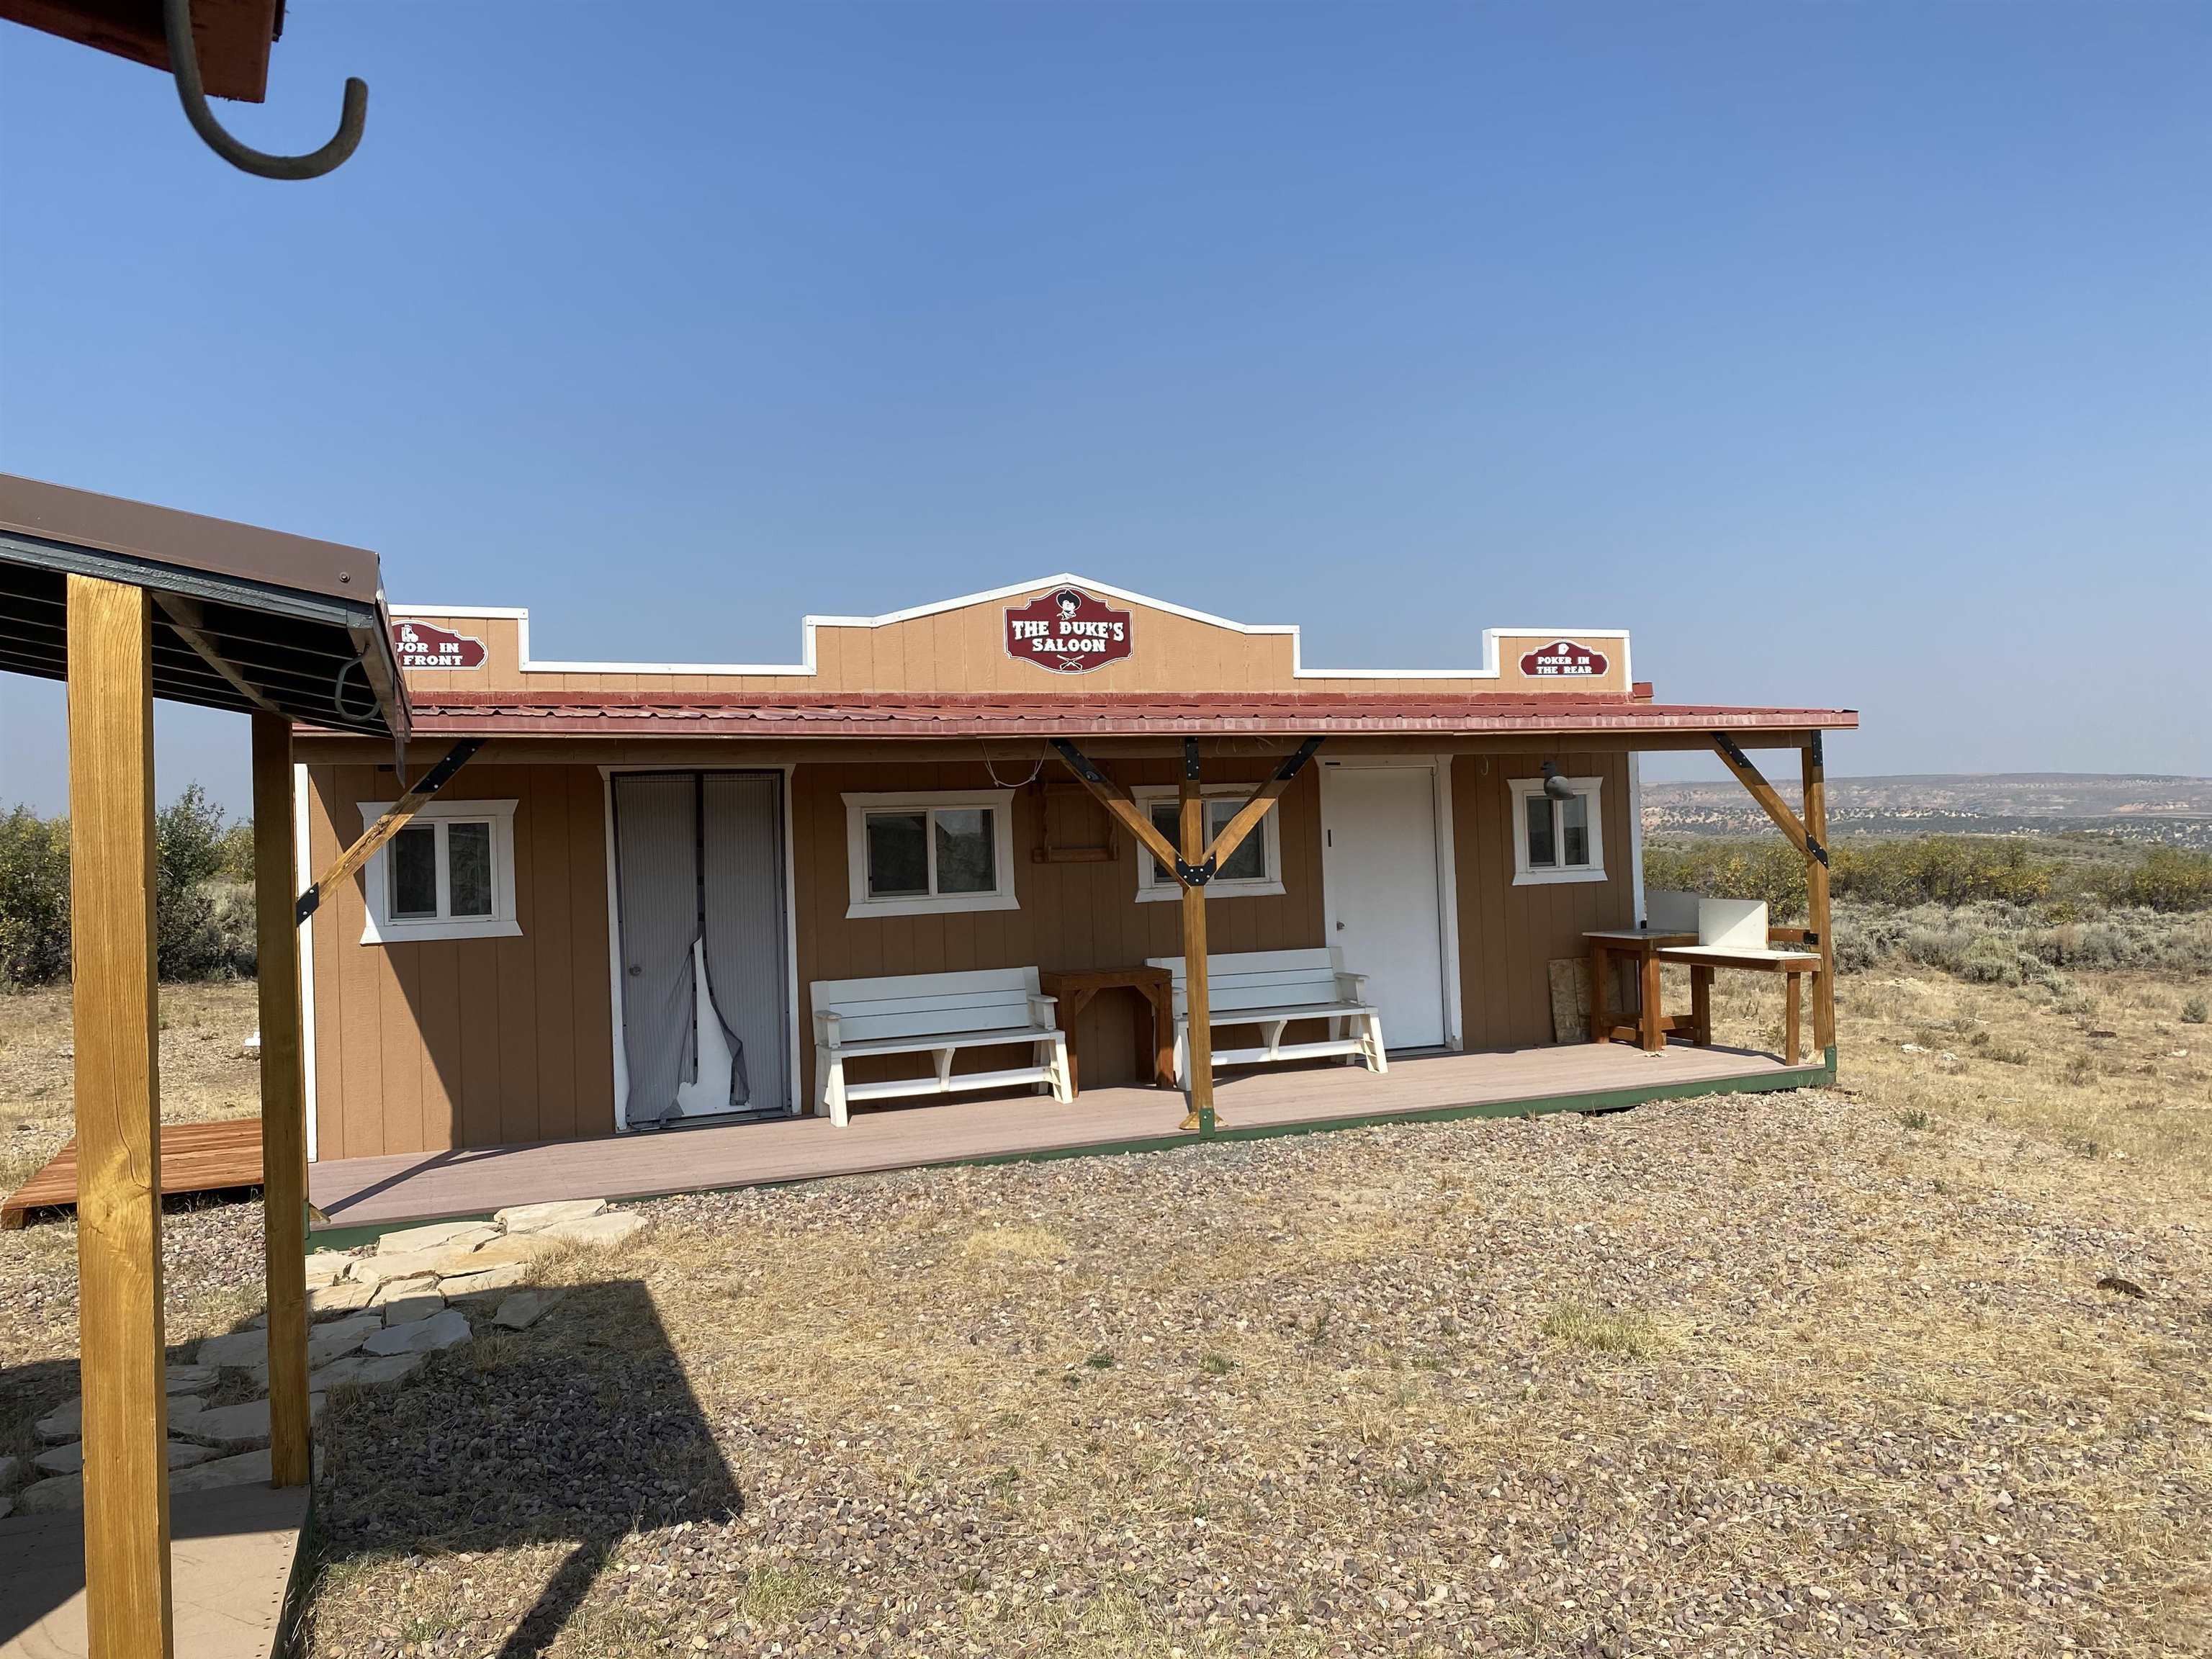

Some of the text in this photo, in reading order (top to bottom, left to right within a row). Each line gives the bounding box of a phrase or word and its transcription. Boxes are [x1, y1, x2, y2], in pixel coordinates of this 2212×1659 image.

[1012, 621, 1124, 641] THE DUKE'S
[440, 643, 459, 652] IN
[1032, 639, 1106, 652] SALOON
[403, 655, 463, 665] FRONT
